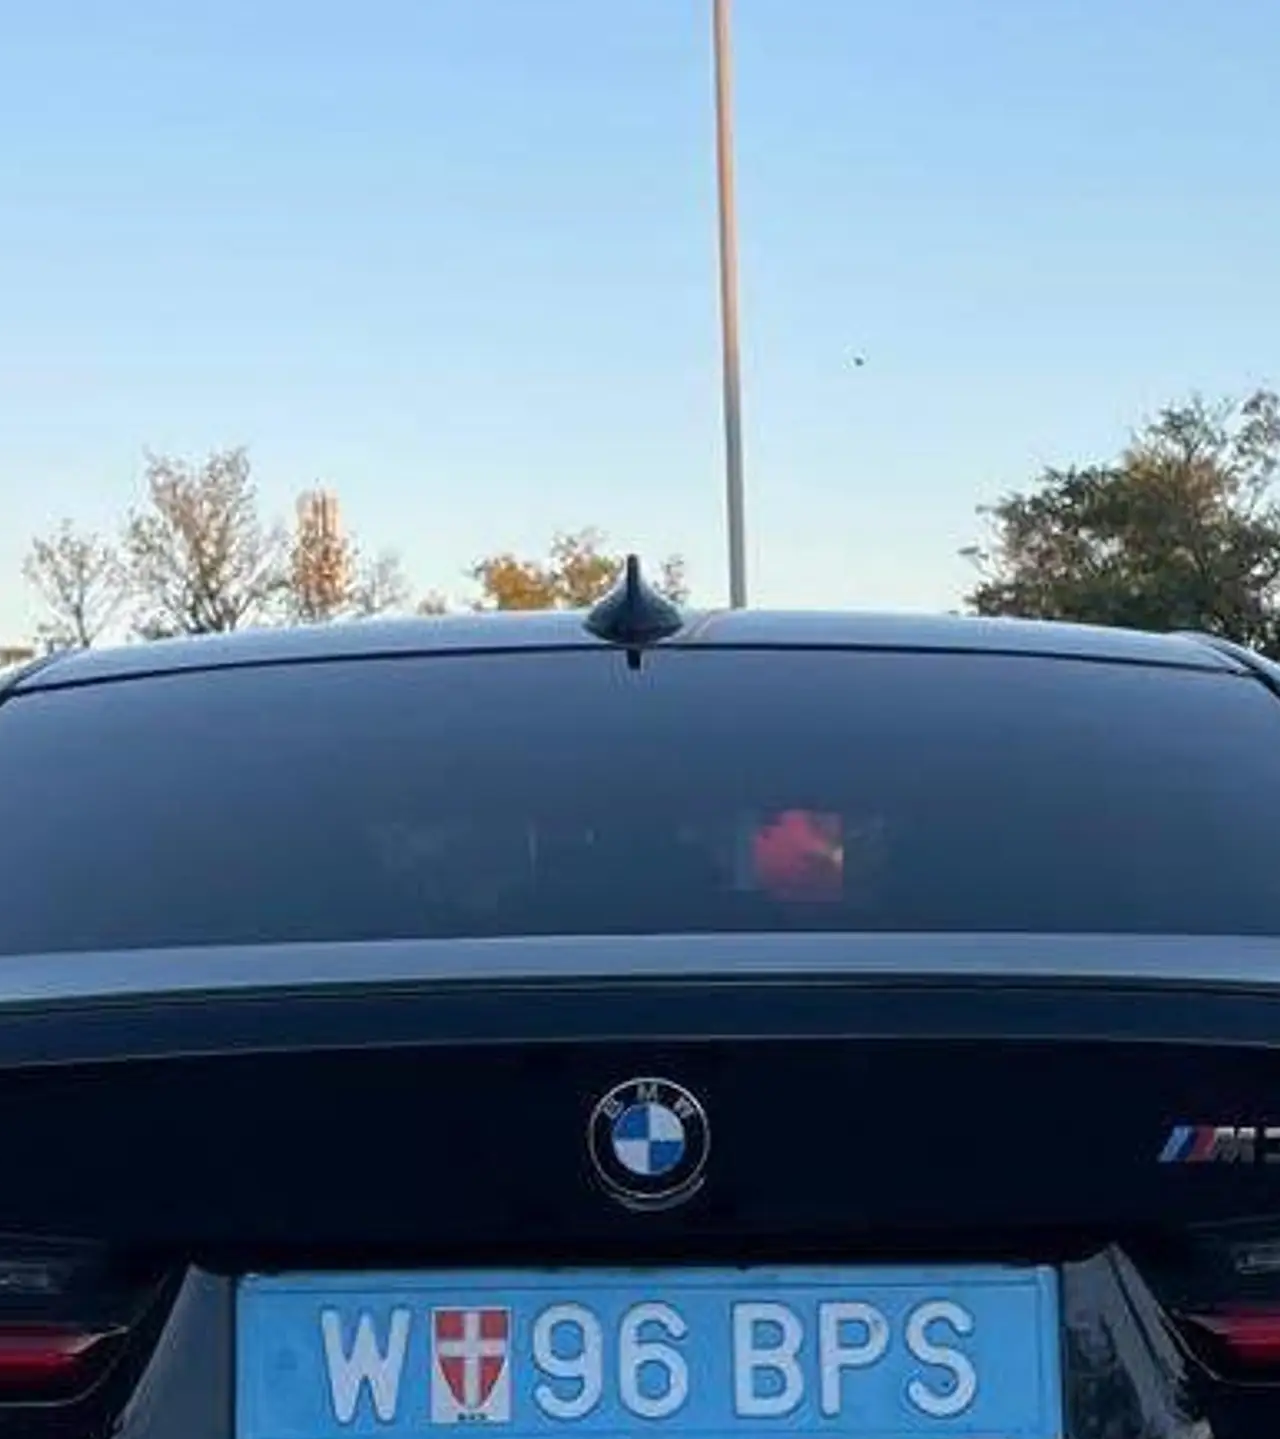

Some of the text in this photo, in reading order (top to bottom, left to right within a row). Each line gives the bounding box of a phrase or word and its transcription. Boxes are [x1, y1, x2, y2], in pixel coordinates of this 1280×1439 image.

[603, 1083, 694, 1119] BMW
[321, 1300, 978, 1425] W 96 BPS
